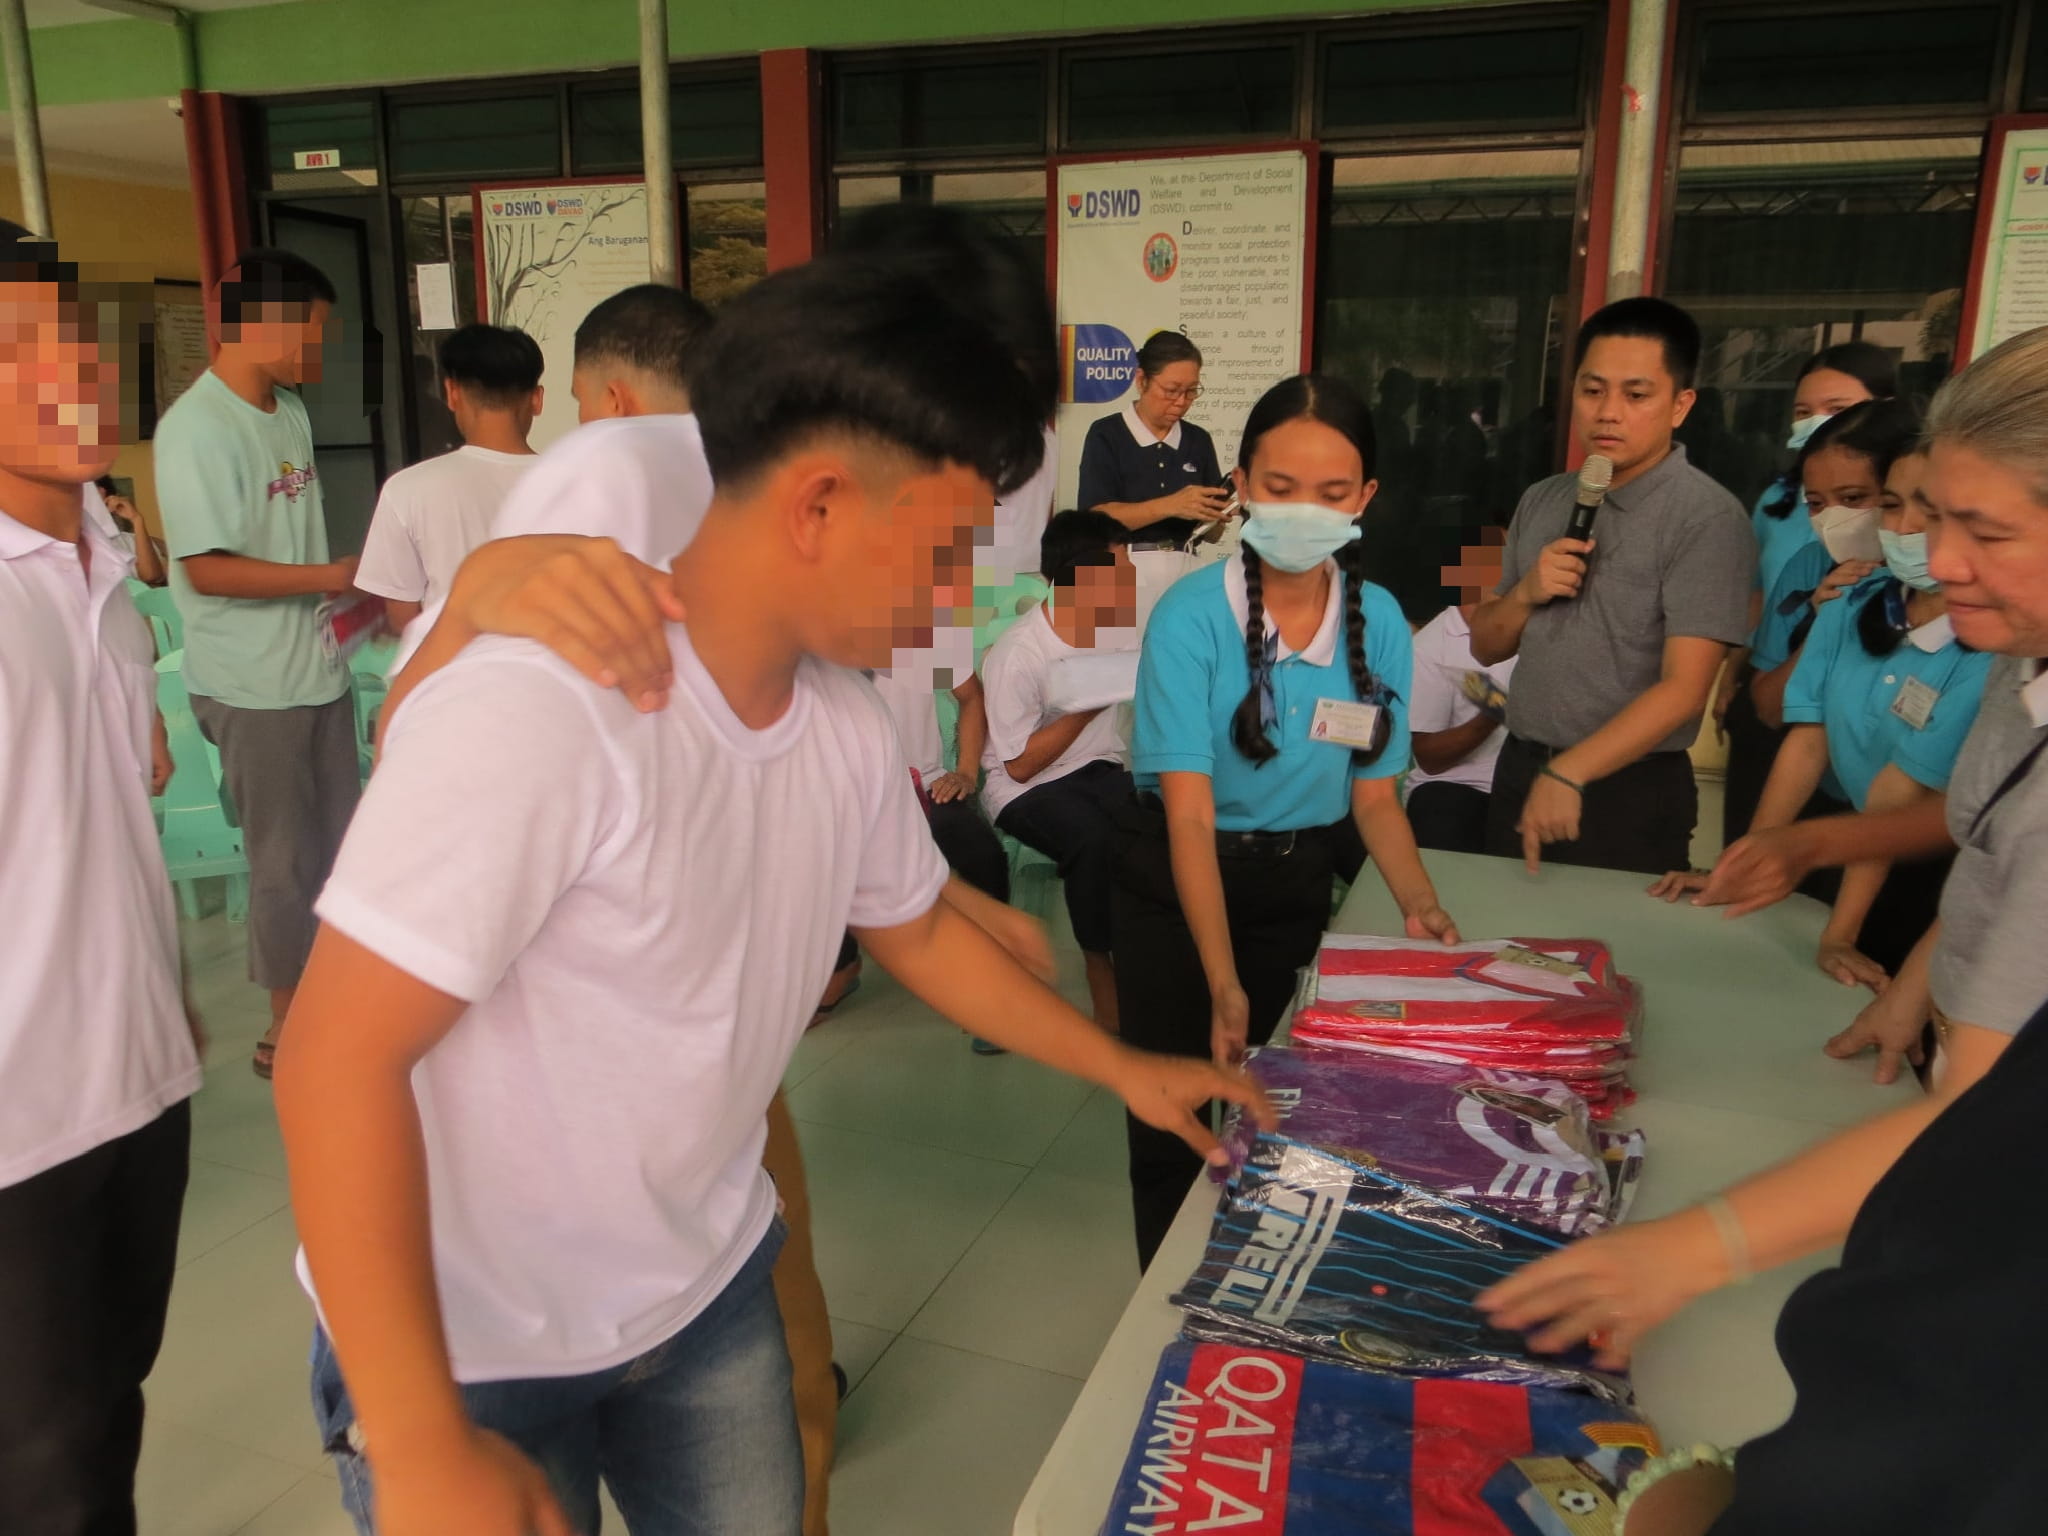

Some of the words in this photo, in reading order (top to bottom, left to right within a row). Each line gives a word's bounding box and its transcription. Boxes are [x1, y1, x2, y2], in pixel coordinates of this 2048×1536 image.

[505, 201, 542, 216] DSWD
[1086, 188, 1140, 219] DSWD
[1077, 347, 1131, 361] QUALITY
[1086, 367, 1133, 381] POLICY
